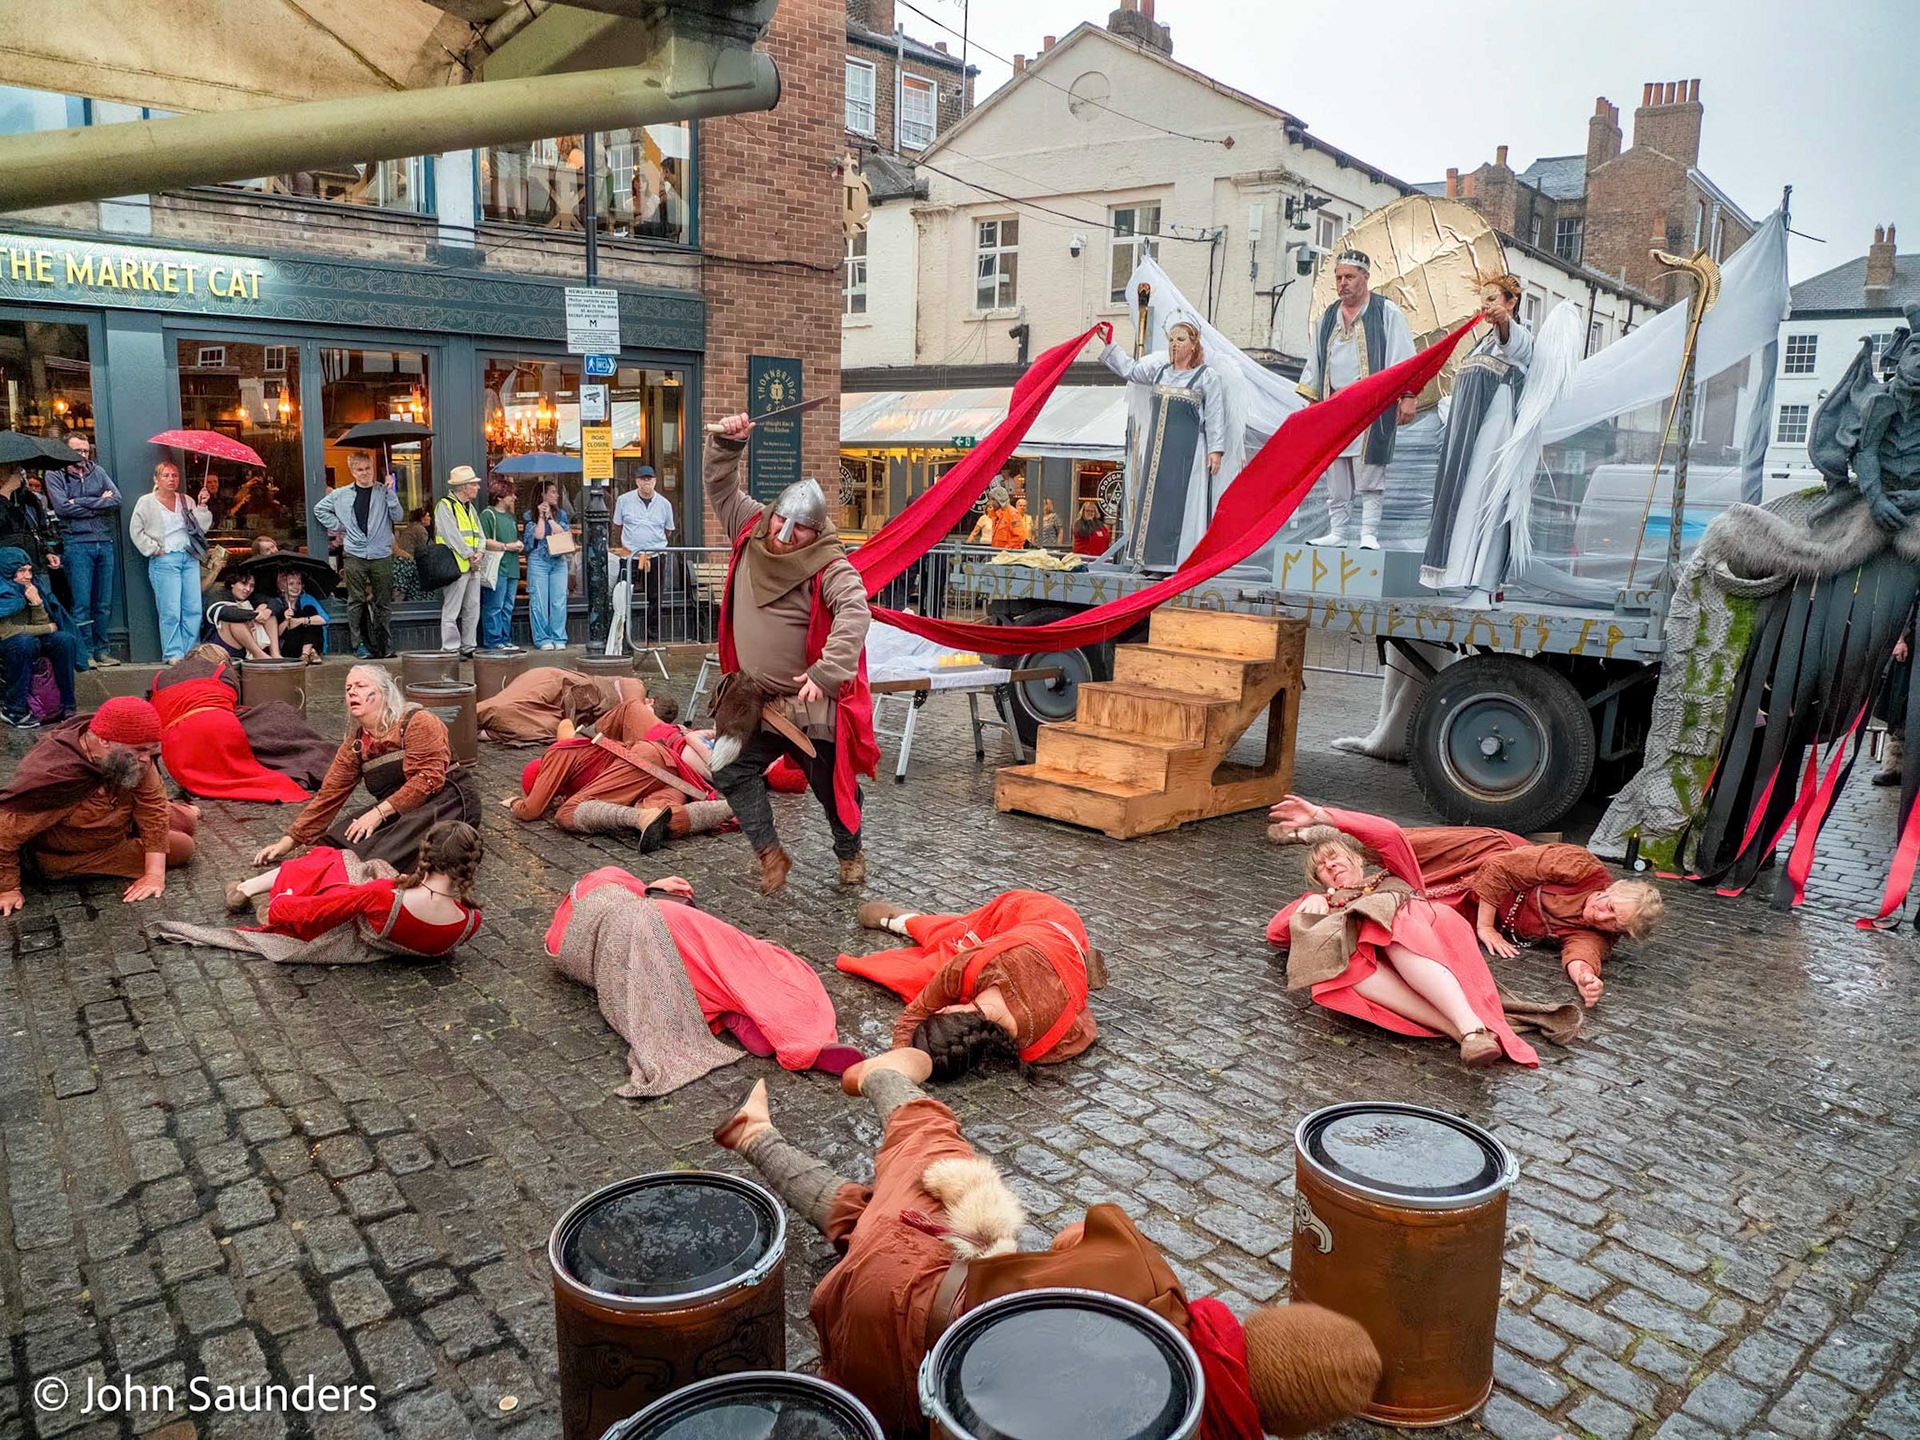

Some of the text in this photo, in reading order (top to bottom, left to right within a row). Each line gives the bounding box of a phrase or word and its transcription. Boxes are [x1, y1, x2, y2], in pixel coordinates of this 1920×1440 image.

[65, 252, 199, 295] MARKET
[208, 267, 263, 299] CAT
[589, 319, 598, 327] M
[758, 369, 797, 402] THORNBRIDGE
